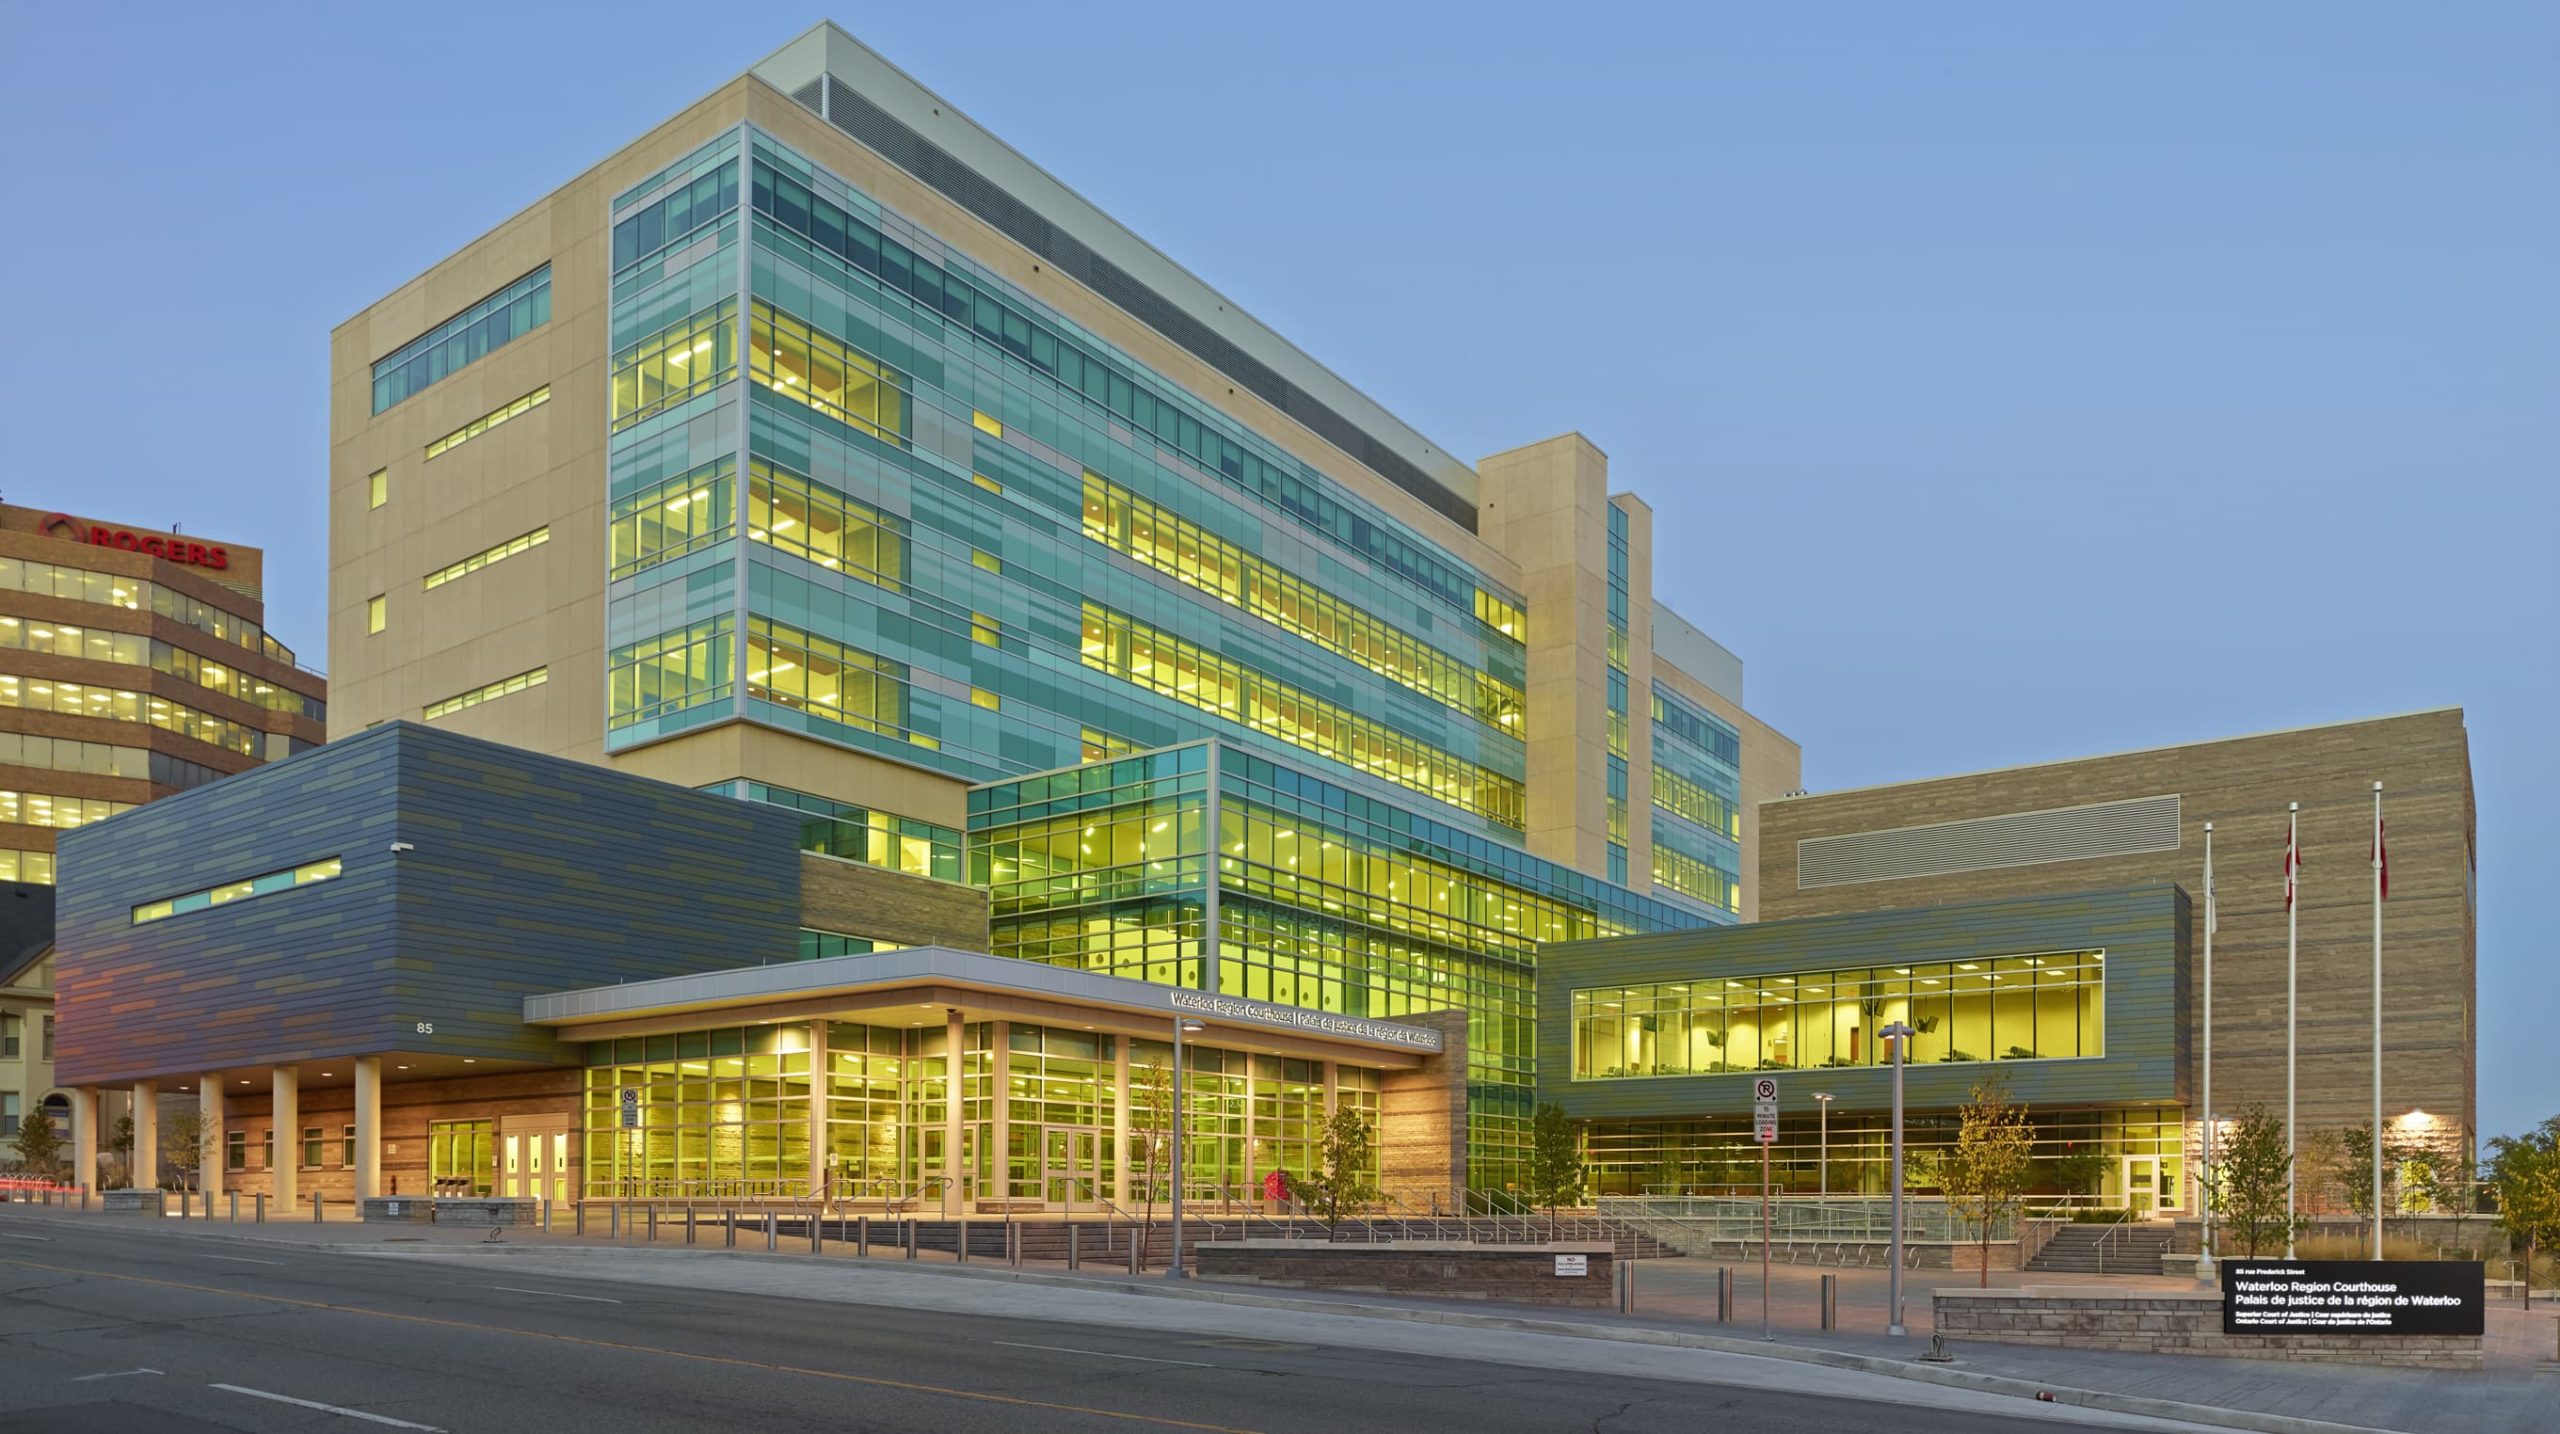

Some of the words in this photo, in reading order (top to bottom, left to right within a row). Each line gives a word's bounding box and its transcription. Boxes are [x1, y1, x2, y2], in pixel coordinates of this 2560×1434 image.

[91, 527, 228, 568] ROGERS
[1170, 992, 1214, 1011] Waterloo
[1214, 1000, 1245, 1016] Region
[1246, 1004, 1293, 1023] Courthouse
[1298, 1013, 1321, 1028] Palais
[1321, 1018, 1332, 1030] de
[1332, 1019, 1356, 1034] justice
[1356, 1023, 1367, 1035] de
[1406, 1031, 1437, 1047] Waterloo
[416, 1022, 433, 1035] 85
[2235, 1281, 2288, 1292] Waterloo
[2291, 1281, 2331, 1294] Region
[2333, 1281, 2397, 1293] Courthouse
[2235, 1294, 2268, 1305] Palais
[2271, 1294, 2286, 1306] de
[2287, 1294, 2325, 1307] justice
[2327, 1295, 2342, 1306] de
[2344, 1295, 2354, 1306] la
[2356, 1295, 2392, 1307] région
[2394, 1296, 2409, 1306] de
[2411, 1295, 2461, 1306] Waterloo
[2235, 1311, 2261, 1319] Superior
